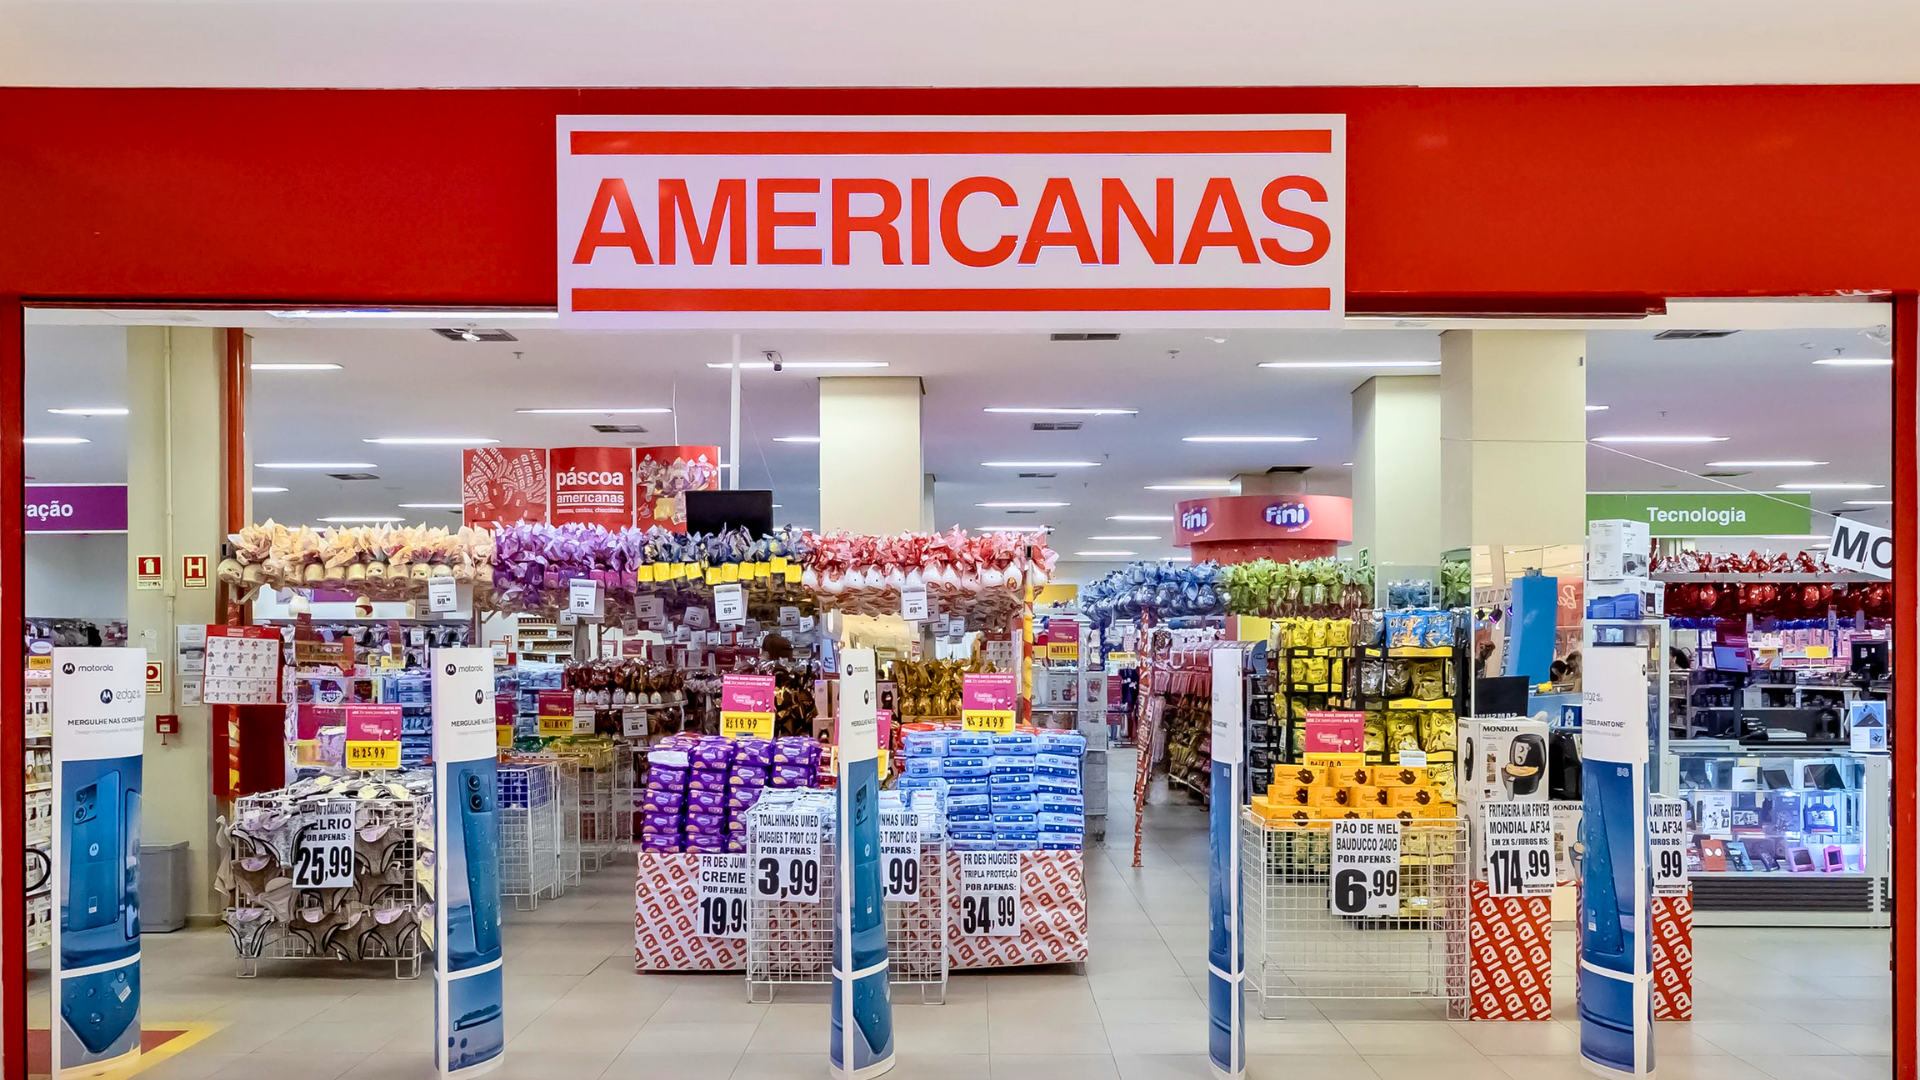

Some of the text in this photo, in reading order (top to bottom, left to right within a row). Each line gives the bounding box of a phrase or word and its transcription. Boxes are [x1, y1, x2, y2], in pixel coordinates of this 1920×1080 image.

[570, 174, 1331, 267] AMERICANAS
[556, 467, 624, 490] páscoa
[556, 493, 624, 503] americanas
[24, 500, 73, 521] ação
[1266, 504, 1305, 524] Fini
[1646, 506, 1746, 526] Tecnologia
[1182, 507, 1207, 530] Fini
[187, 558, 203, 577] H
[78, 664, 114, 672] motorola
[116, 688, 136, 703] edge
[327, 804, 352, 815] CALCINHAS
[1489, 804, 1550, 817] FRITADEIRA AIR FRYER
[1654, 804, 1683, 817] AIR FRYER
[760, 814, 819, 828] TOALHINHAS UMED
[900, 814, 919, 827] UMED
[1490, 820, 1551, 834] MONDIAL AF34
[1336, 821, 1399, 834] PÃO DE MEL
[1662, 821, 1683, 834] AF34
[303, 834, 317, 842] POR
[319, 833, 346, 841] APENAS
[758, 831, 783, 843] HUGGIES
[785, 832, 789, 843] T
[790, 832, 804, 844] PROT
[890, 832, 904, 843] PROT
[1511, 838, 1538, 846] S/JUROS
[761, 847, 778, 855] POR
[780, 847, 812, 855] APENAS
[881, 847, 912, 855] APENAS
[1337, 838, 1397, 851] BAUDUCCO 240G
[296, 846, 352, 886] 25,99
[703, 856, 712, 868] FR
[714, 856, 728, 868] DES
[964, 854, 1018, 865] FR DES HUGGIES
[1338, 855, 1356, 863] POR
[1358, 855, 1391, 864] APENAS
[702, 871, 746, 884] CREME
[758, 858, 818, 899] 3,99
[964, 869, 1018, 879] TRIPLA PROTEÇÃO
[1490, 850, 1550, 895] 174,99
[703, 886, 719, 894] POR
[1335, 869, 1397, 913] 6,99
[963, 896, 1015, 934] 34,99
